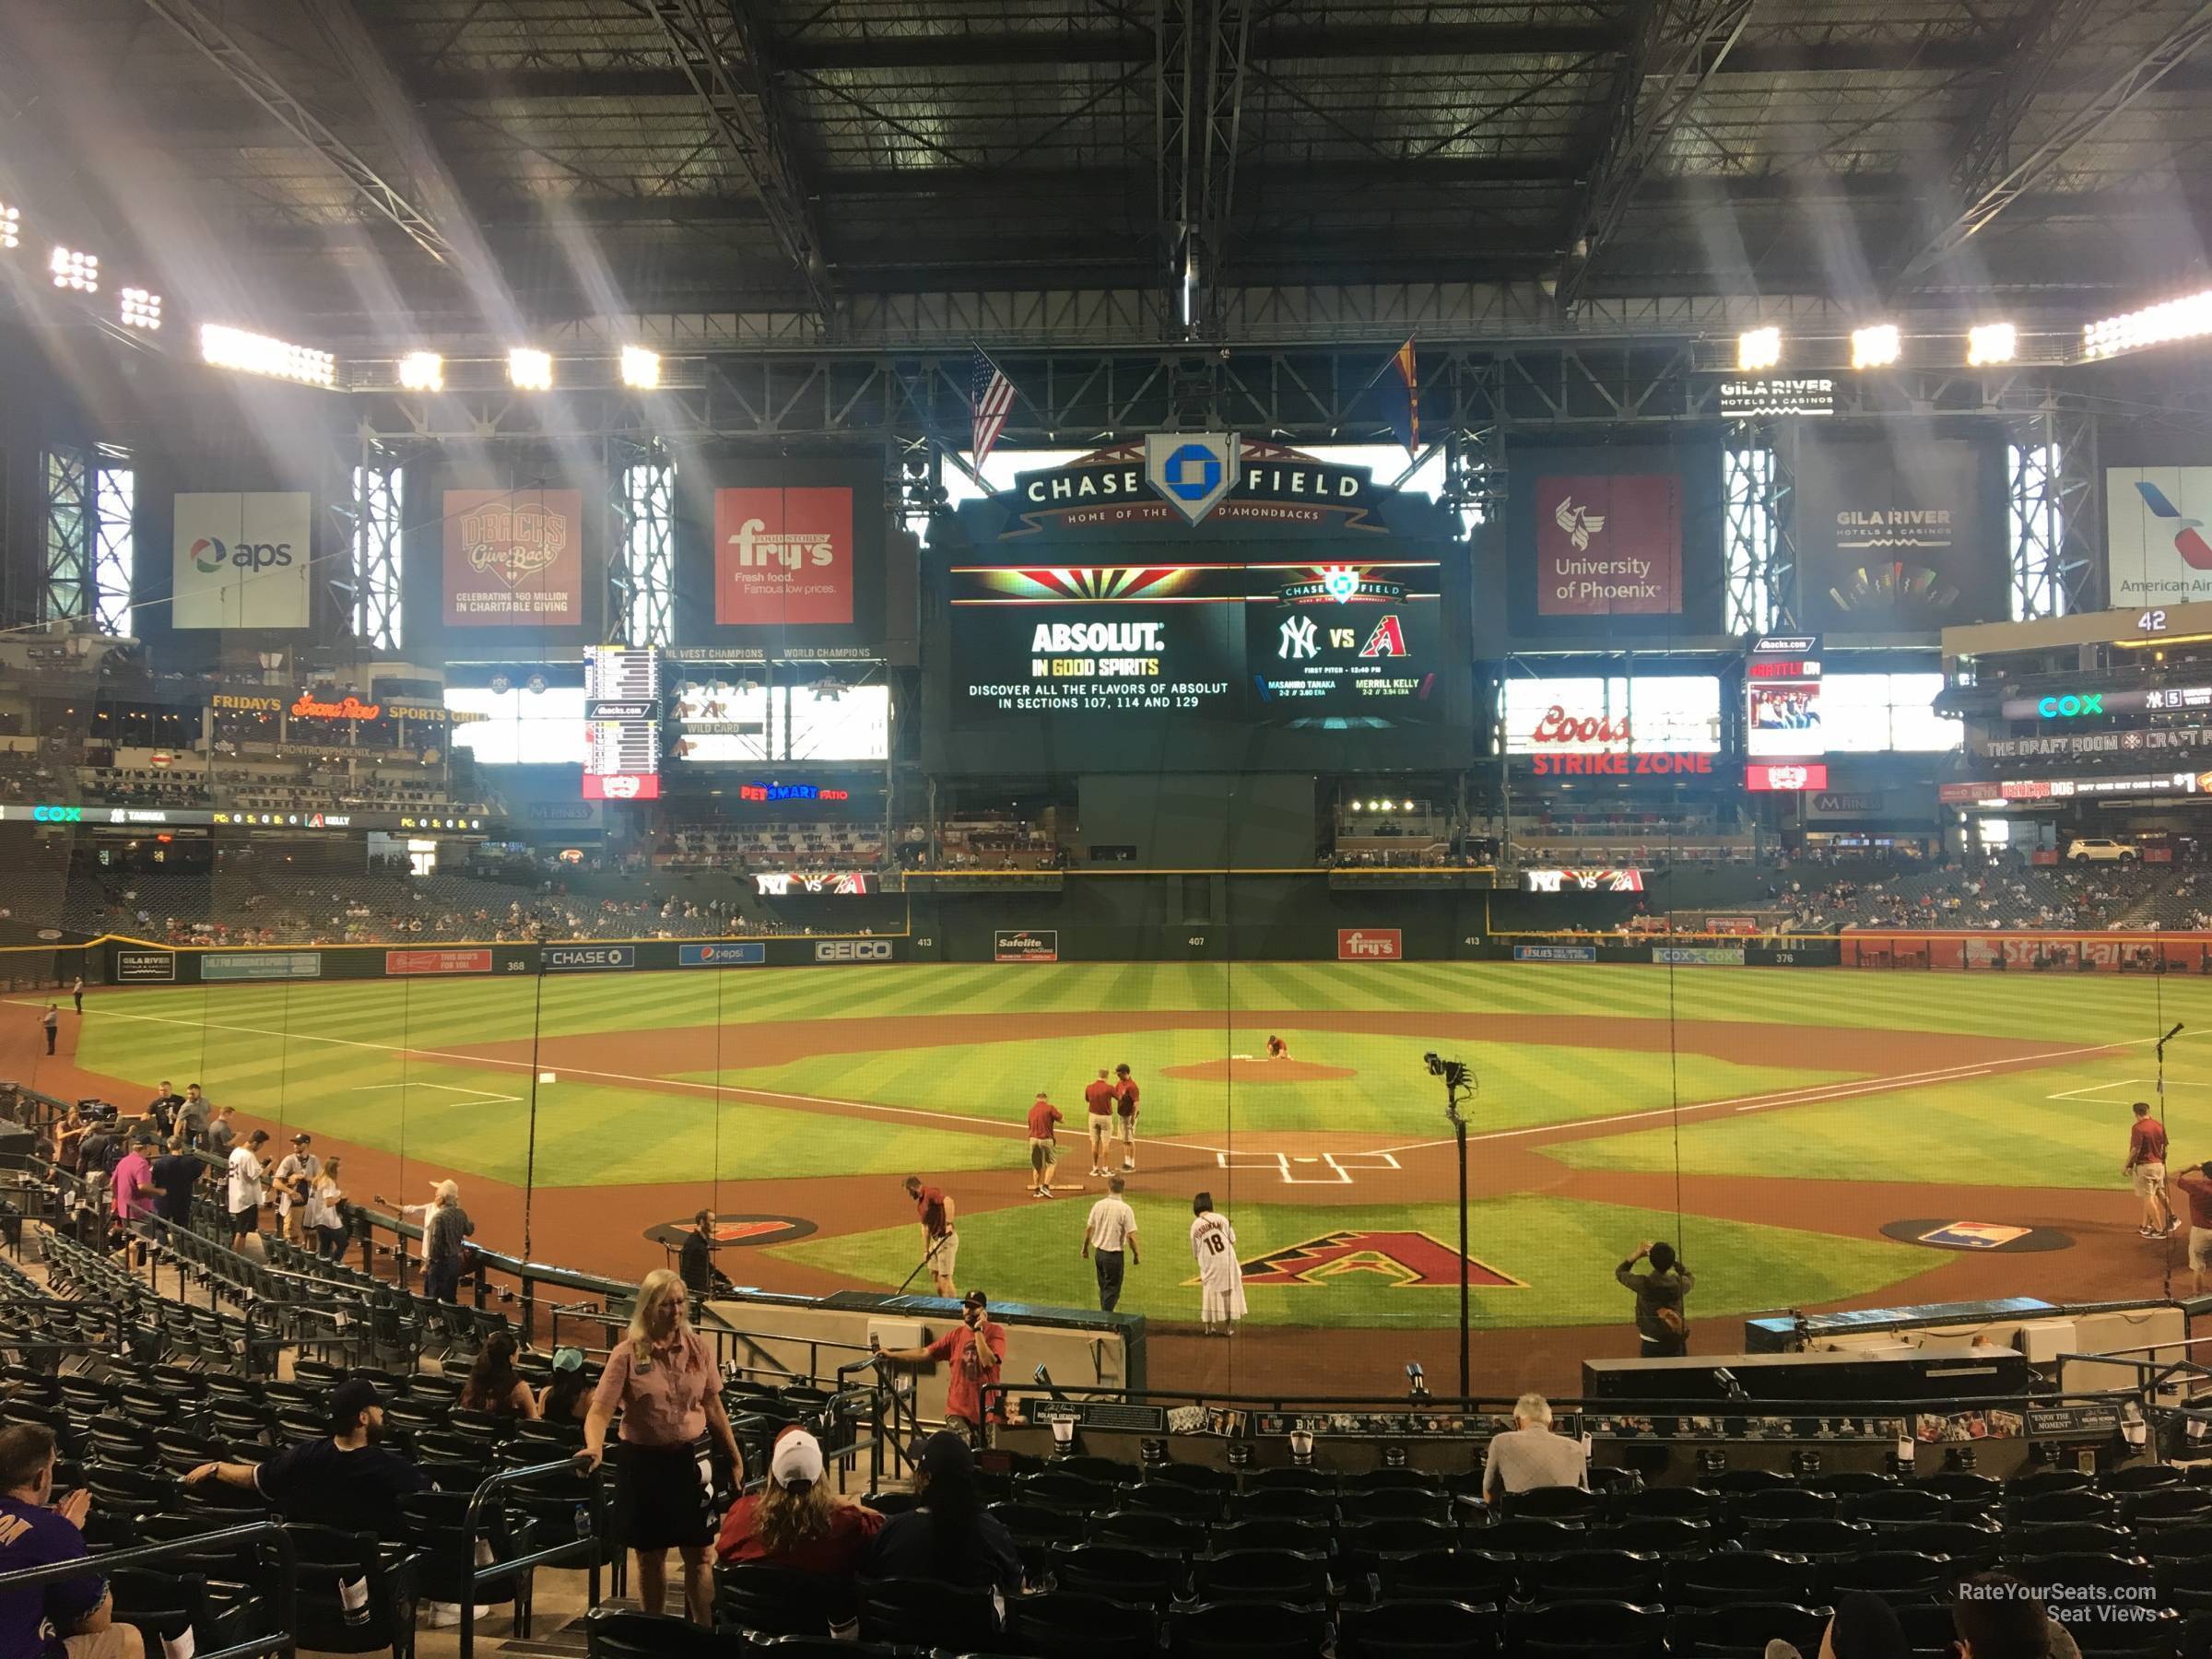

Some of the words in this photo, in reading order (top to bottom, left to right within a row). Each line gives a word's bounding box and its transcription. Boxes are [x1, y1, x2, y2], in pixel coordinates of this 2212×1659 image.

[1721, 381, 1768, 395] GILA
[1771, 379, 1832, 394] RIVER
[1028, 472, 1138, 502] CHASE
[1249, 470, 1359, 498] FIELD
[1068, 512, 1106, 524] HOME
[1116, 510, 1133, 519] OF
[1143, 508, 1168, 517] THE
[1837, 511, 1884, 525] GILA
[1888, 510, 1951, 524] RIVER
[728, 519, 833, 570] fry's
[232, 544, 274, 572] aps
[471, 544, 510, 570] Give
[510, 544, 554, 570] Back
[1556, 557, 1652, 579] University
[735, 572, 765, 582] Fresh
[767, 572, 794, 582] food.
[744, 584, 783, 594] Famous
[785, 584, 803, 594] low
[805, 584, 837, 595] prices.
[1285, 584, 1324, 596] CHASE
[1360, 583, 1400, 594] FIELD
[1556, 582, 1577, 599] of
[1580, 581, 1656, 598] Phoenix
[2121, 579, 2190, 592] American
[456, 593, 512, 601] CELEBRATING
[515, 593, 532, 601] $60
[456, 602, 467, 612] IN
[470, 602, 531, 612] CHARITABLE
[534, 602, 568, 612] GIVING
[2137, 610, 2166, 631] 42
[1329, 628, 1355, 649] VS
[1760, 641, 1806, 650] dbacks.com
[665, 649, 677, 658] NL
[679, 649, 706, 658] WEST
[709, 648, 764, 658] CHAMPIONS
[783, 648, 814, 658] WORLD
[817, 648, 871, 657] CHAMPIONS
[1031, 659, 1049, 677] IN
[1052, 659, 1095, 677] GOOD
[1098, 658, 1159, 677] SPIRITS
[1268, 681, 1306, 689] MASAHIRO
[1307, 680, 1336, 688] TANAKA
[1356, 679, 1392, 688] MERRILL
[1393, 678, 1419, 688] KELLY
[969, 685, 1030, 697] DISCOVER
[1035, 685, 1058, 696] ALL
[1062, 684, 1087, 695] THE
[1091, 684, 1146, 695] FLAVORS
[1150, 683, 1166, 694] OF
[1171, 683, 1229, 694] ABSOLUT
[213, 695, 281, 711] FRIDAY'S
[998, 698, 1012, 709] IN
[1017, 698, 1078, 709] SECTIONS
[1084, 698, 1112, 710] 107,
[1117, 697, 1140, 708] 114
[1144, 697, 1171, 708] AND
[1175, 697, 1199, 708] 129
[2169, 692, 2179, 705] 5
[340, 697, 381, 720] Row
[597, 706, 642, 715] dbacks.com
[2038, 693, 2103, 718] COX
[388, 706, 446, 722] SPORTS
[688, 724, 712, 734] WILD
[713, 723, 740, 733] CARD
[1533, 705, 1630, 743] Coors
[1987, 743, 2016, 758] THE
[2019, 738, 2068, 755] DRAFT
[2072, 735, 2118, 752] ROOM
[2146, 730, 2198, 748] CRAFT
[1533, 753, 1630, 775] STRIKE
[1635, 752, 1712, 774] ZONE
[740, 783, 818, 801] PETSMART
[819, 790, 848, 800] PATIO
[33, 806, 81, 821] COX
[213, 814, 229, 823] PC:
[325, 816, 350, 826] KELLY
[401, 818, 415, 828] PC:
[804, 879, 823, 892] VS
[1578, 876, 1597, 888] VS
[917, 937, 933, 947] 413
[998, 938, 1042, 947] Safelite
[1188, 936, 1206, 946] 407
[1346, 932, 1394, 956] fry's
[1465, 936, 1480, 946] 413
[552, 951, 606, 964] CHASE
[715, 947, 745, 961] pepsi
[817, 942, 891, 961] GEICO
[1663, 950, 1689, 961] COX
[1706, 950, 1734, 961] COX
[1776, 953, 1794, 963] 376
[2002, 939, 2074, 964] State
[507, 961, 525, 971] 368
[1203, 1233, 1225, 1256] 18
